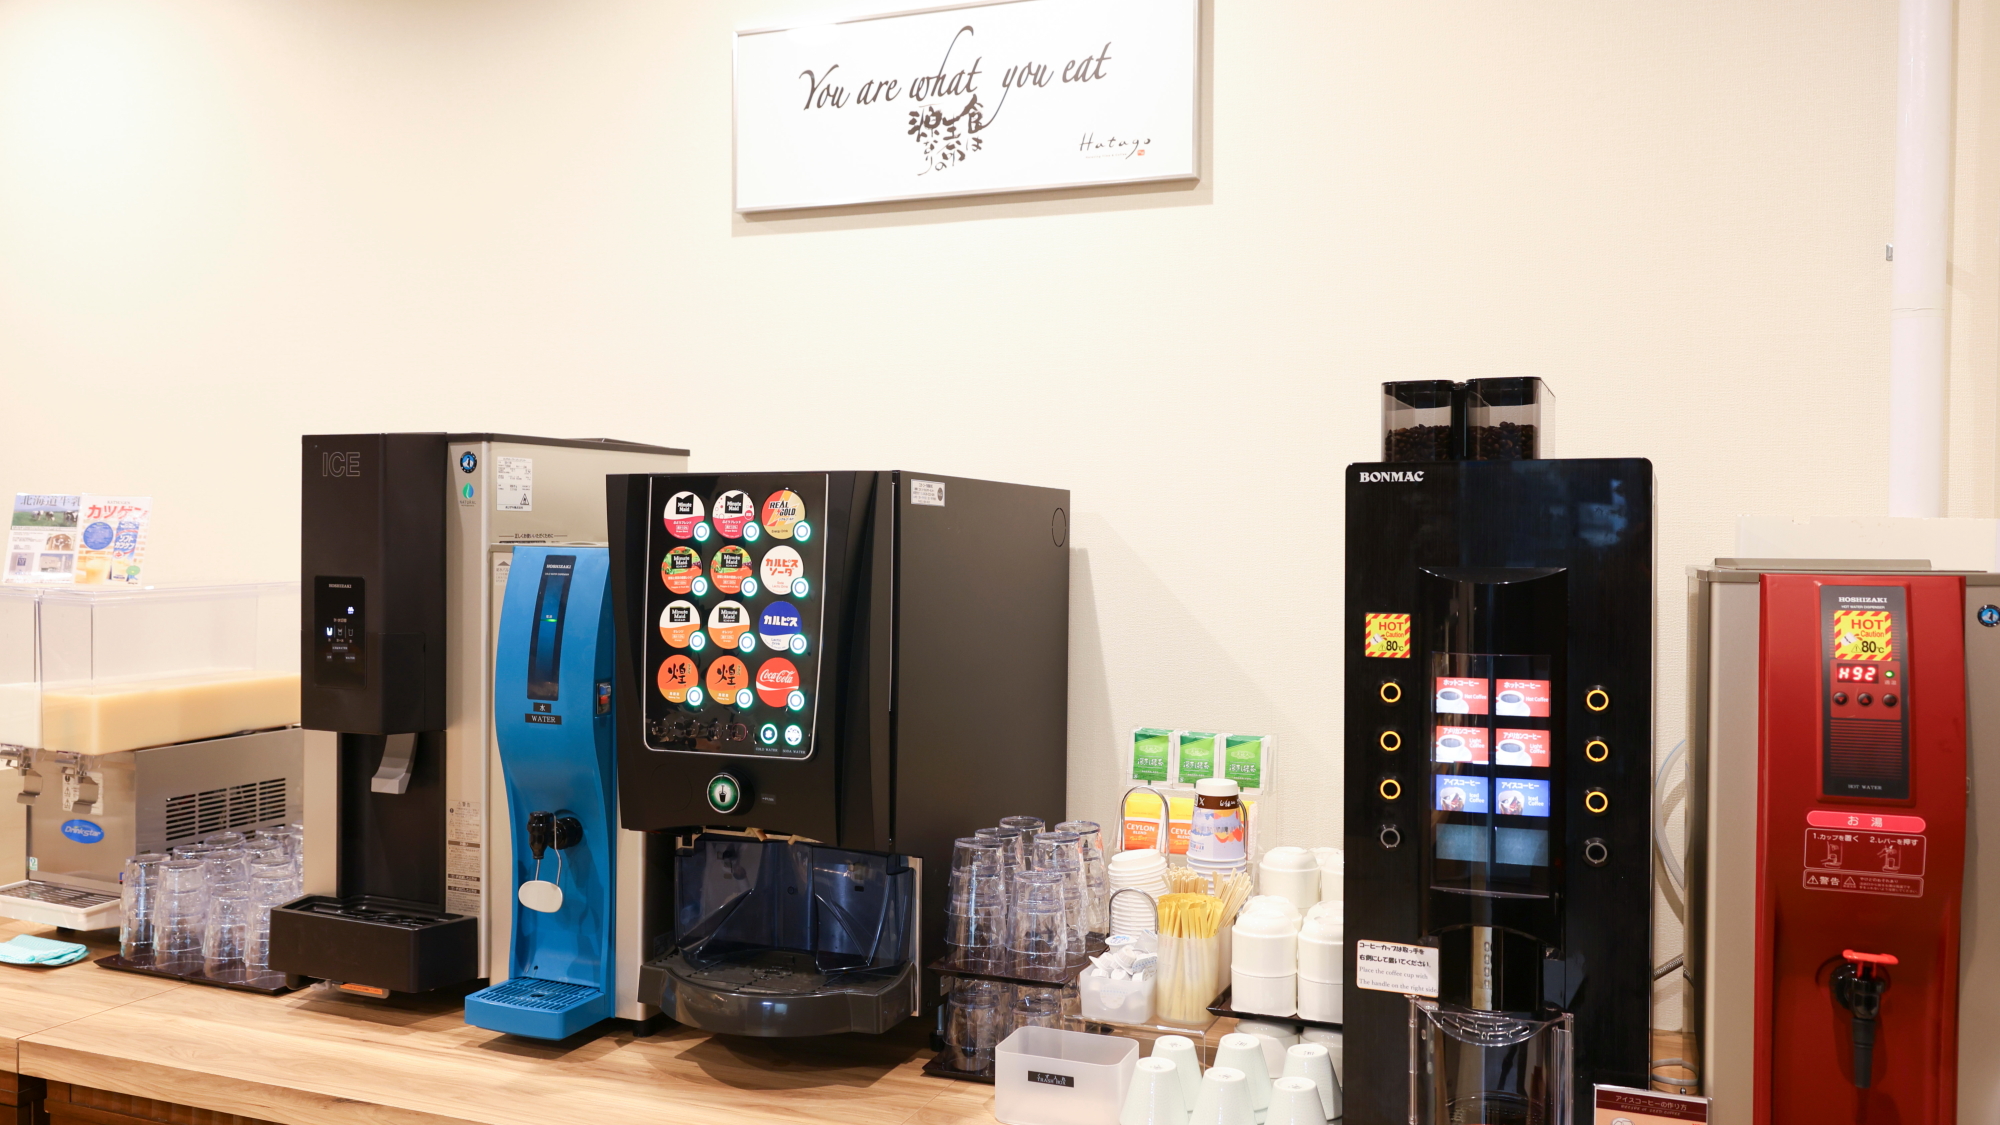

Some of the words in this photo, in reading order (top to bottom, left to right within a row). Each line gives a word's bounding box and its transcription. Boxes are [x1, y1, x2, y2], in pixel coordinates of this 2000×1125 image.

[799, 63, 850, 111] You
[855, 76, 901, 106] are
[909, 25, 982, 103] what
[1062, 41, 1112, 84] eat
[322, 452, 361, 477] ICE
[1359, 471, 1425, 483] BONMAC
[769, 500, 789, 509] REAL
[765, 558, 799, 568] カルピス
[769, 567, 794, 577] ソーダ
[763, 615, 798, 627] カルピス
[1379, 622, 1404, 631] HOT
[1851, 619, 1884, 630] HOT
[1860, 630, 1884, 638] Caution
[666, 662, 687, 684] 煌
[715, 663, 736, 685] 煌
[1443, 679, 1480, 687] ホットコーヒー
[531, 715, 556, 723] WATER
[1443, 778, 1481, 786] アイスコーヒー
[1501, 781, 1540, 790] アイスコーヒー
[1126, 823, 1155, 832] CEYLON
[1359, 942, 1425, 955] コーヒーカップは取っ手を
[1359, 954, 1432, 968] 右側にして置いてください。
[1371, 979, 1390, 988] handle
[1410, 984, 1424, 992] right
[1615, 1095, 1687, 1111] アイスコーヒーの作り方
